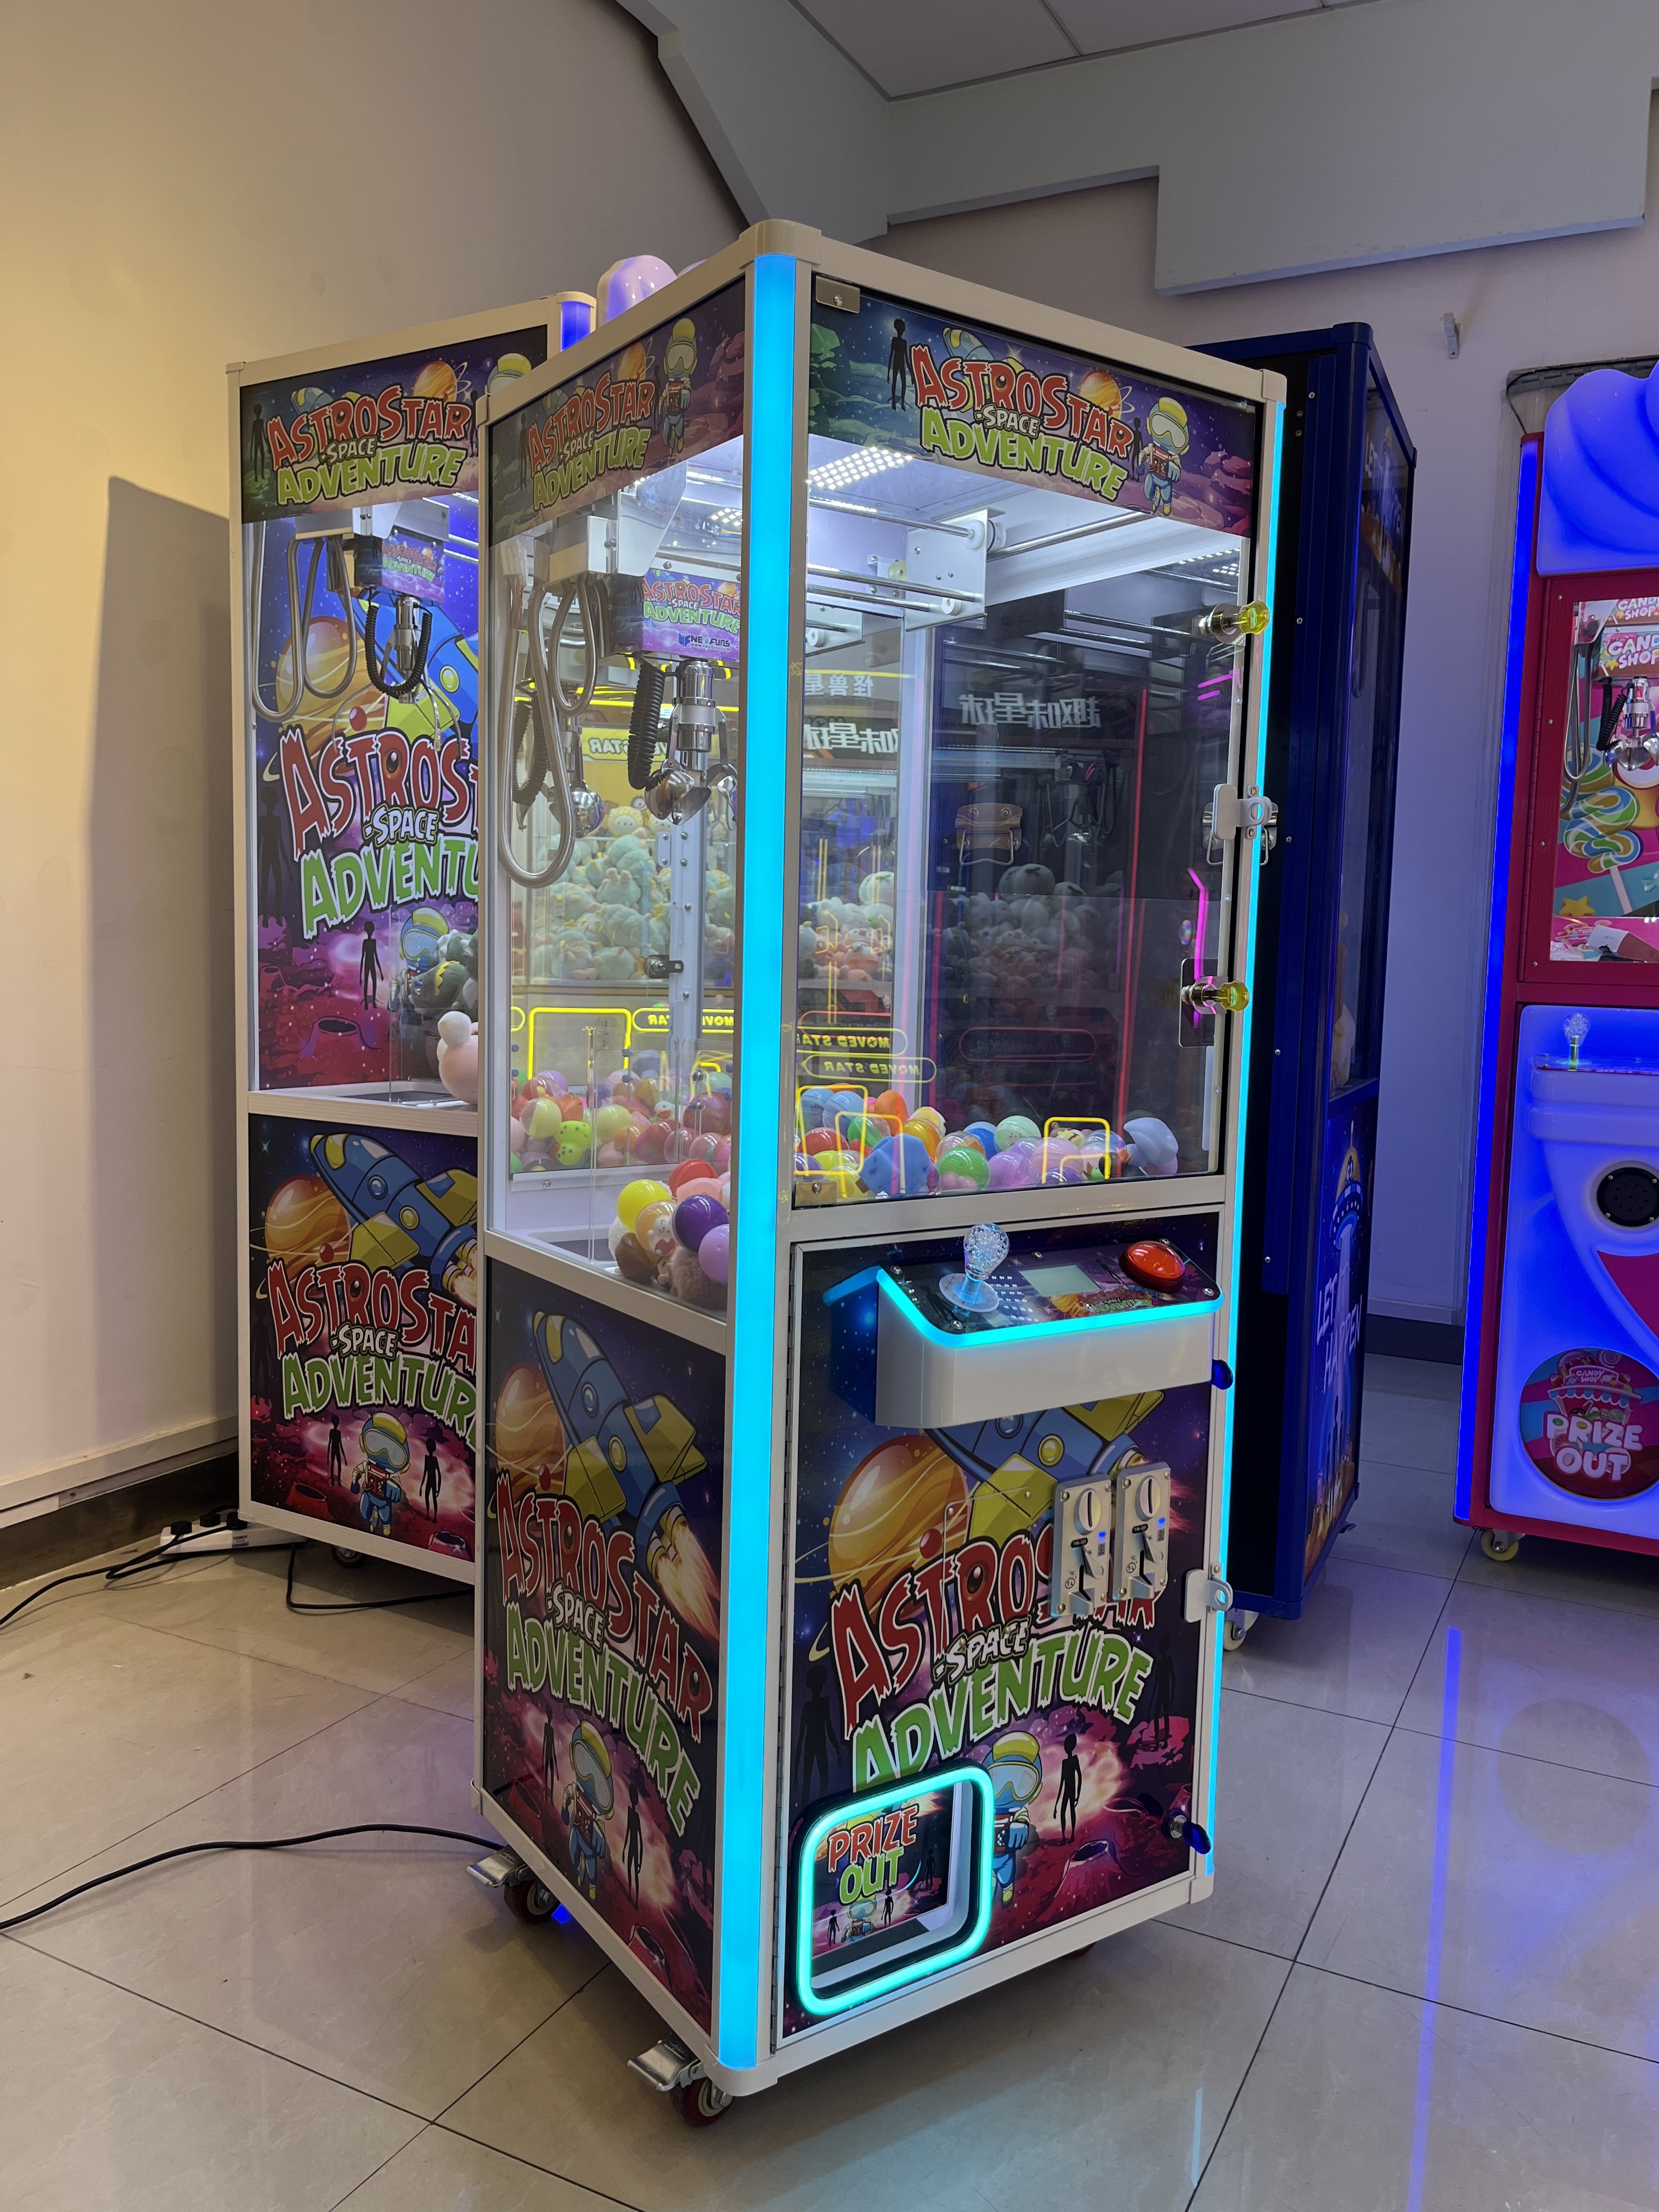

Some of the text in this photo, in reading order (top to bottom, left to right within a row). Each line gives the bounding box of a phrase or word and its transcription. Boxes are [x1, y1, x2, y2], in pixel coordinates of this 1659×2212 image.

[267, 385, 471, 467] ASTROSTAR
[528, 372, 656, 476] ASTROSTAR
[910, 344, 1135, 459] ASTROSTAR
[981, 405, 1041, 437] SPACE
[278, 443, 468, 505] ADVENTURE
[326, 437, 377, 463] SPACE
[533, 426, 651, 511] ADVENTURE
[562, 431, 594, 461] SPACE
[921, 408, 1128, 501] ADVENTURE
[644, 601, 741, 634] ADVENTURE
[670, 599, 698, 610] SPACE
[1625, 606, 1656, 620] SHOP
[1618, 649, 1659, 669] SHOP
[373, 808, 438, 843] SPACE
[338, 1324, 397, 1356] SPACE
[1324, 1294, 1362, 1395] HAPPEN
[1576, 1369, 1605, 1379] CANDY
[1547, 1413, 1643, 1451] PRIZE
[1556, 1447, 1628, 1481] OUT
[497, 1471, 712, 1743] ASTROSTAR
[552, 1585, 604, 1648] SPACE
[831, 1524, 1157, 1740] ASTRO
[946, 1621, 1029, 1680] SPACE
[506, 1601, 701, 1836] ADVENTURE
[853, 1629, 1153, 1792] ADVENTURE
[828, 1805, 919, 1872] PRIZE
[839, 1848, 904, 1904] OUT
